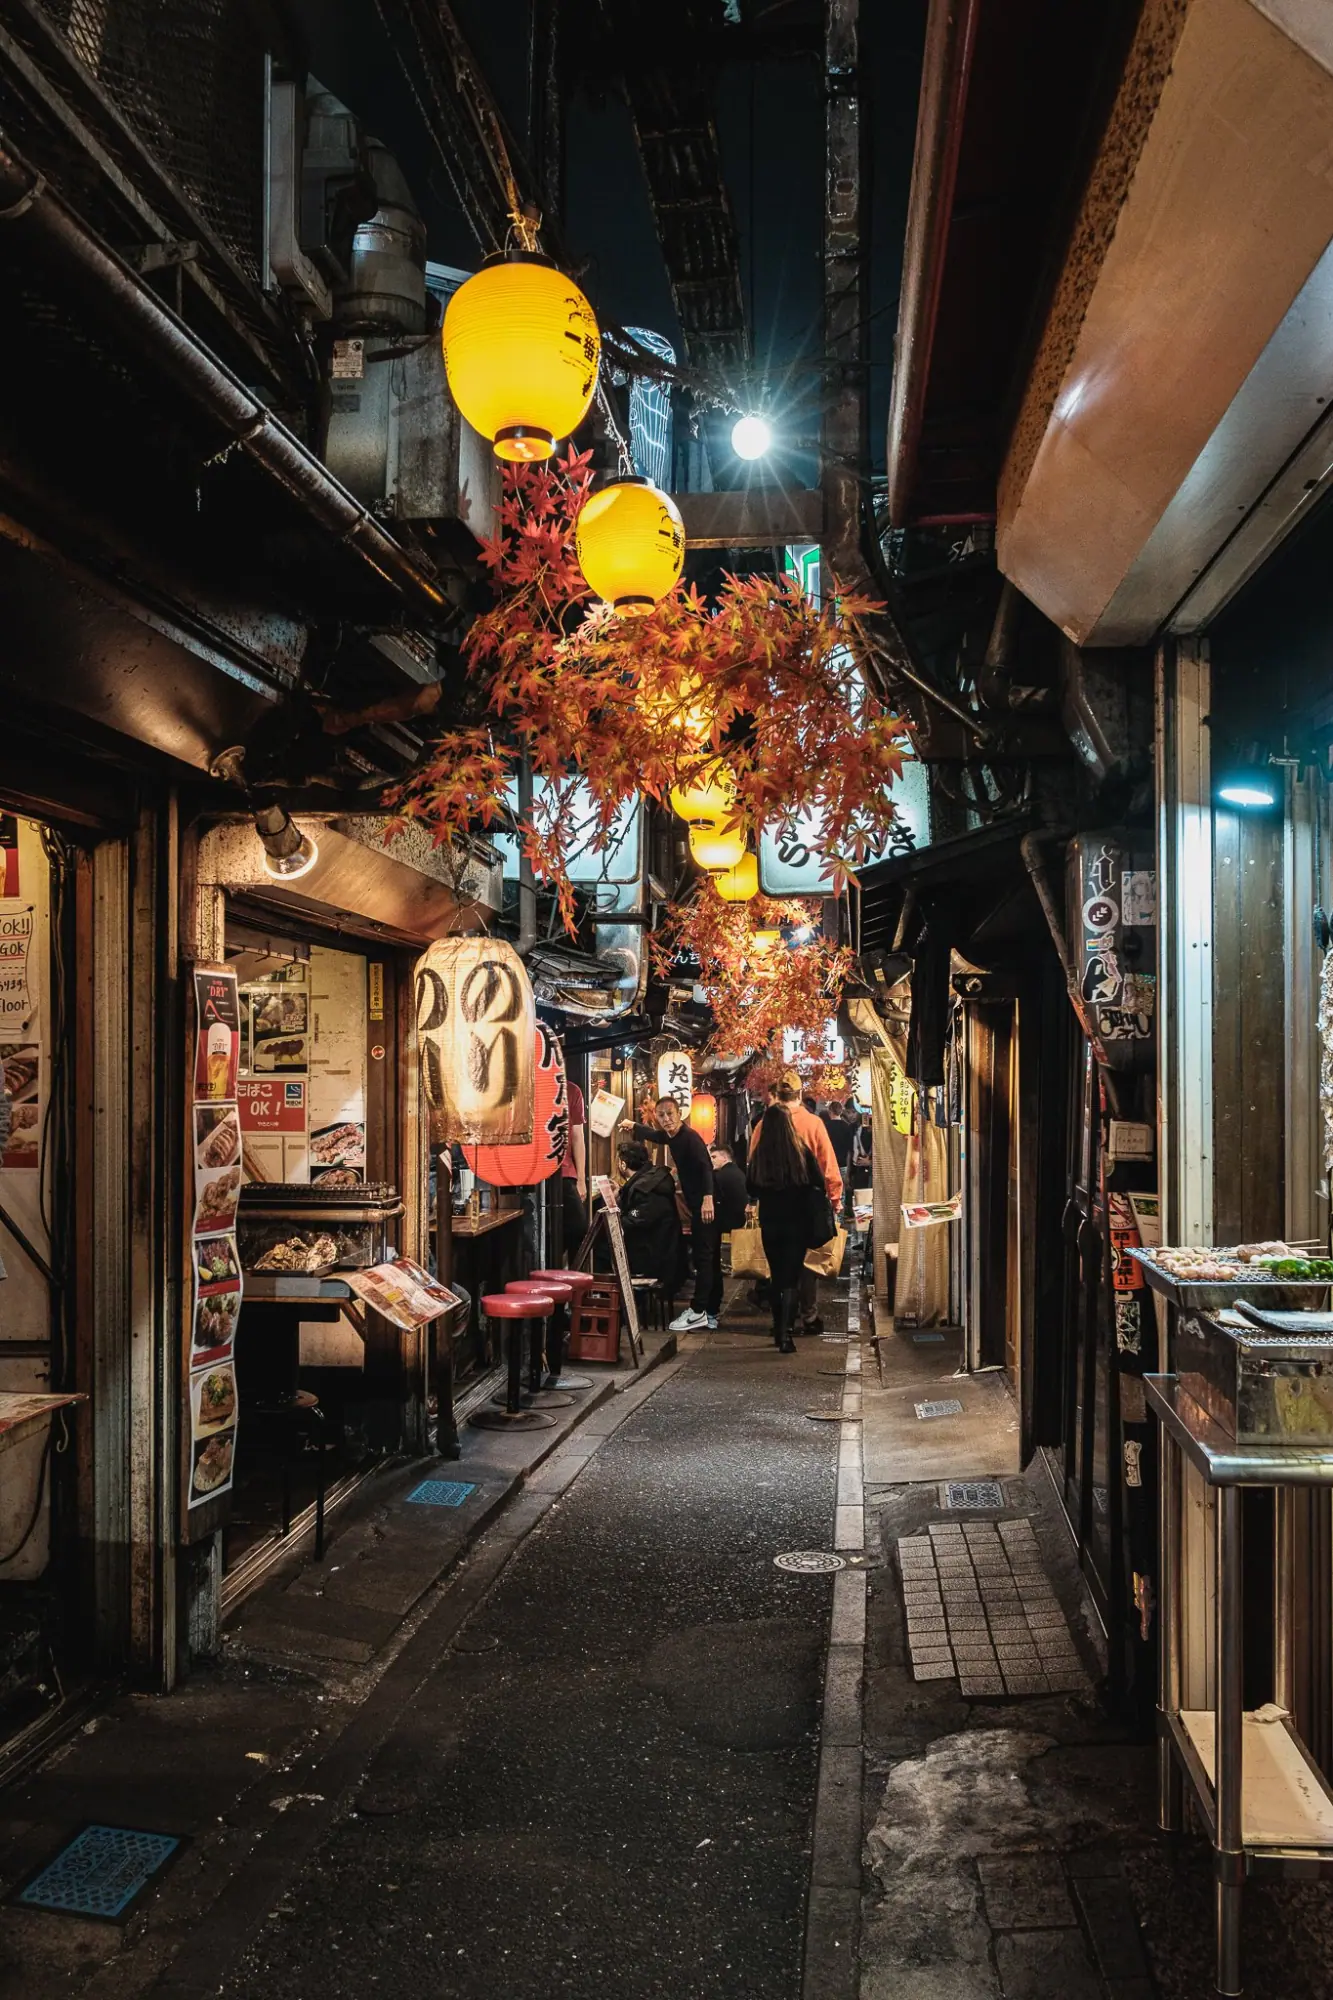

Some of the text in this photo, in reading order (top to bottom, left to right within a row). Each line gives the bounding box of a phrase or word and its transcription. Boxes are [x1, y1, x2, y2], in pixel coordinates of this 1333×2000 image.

[460, 960, 523, 1109] のり
[237, 1083, 273, 1098] たばこ
